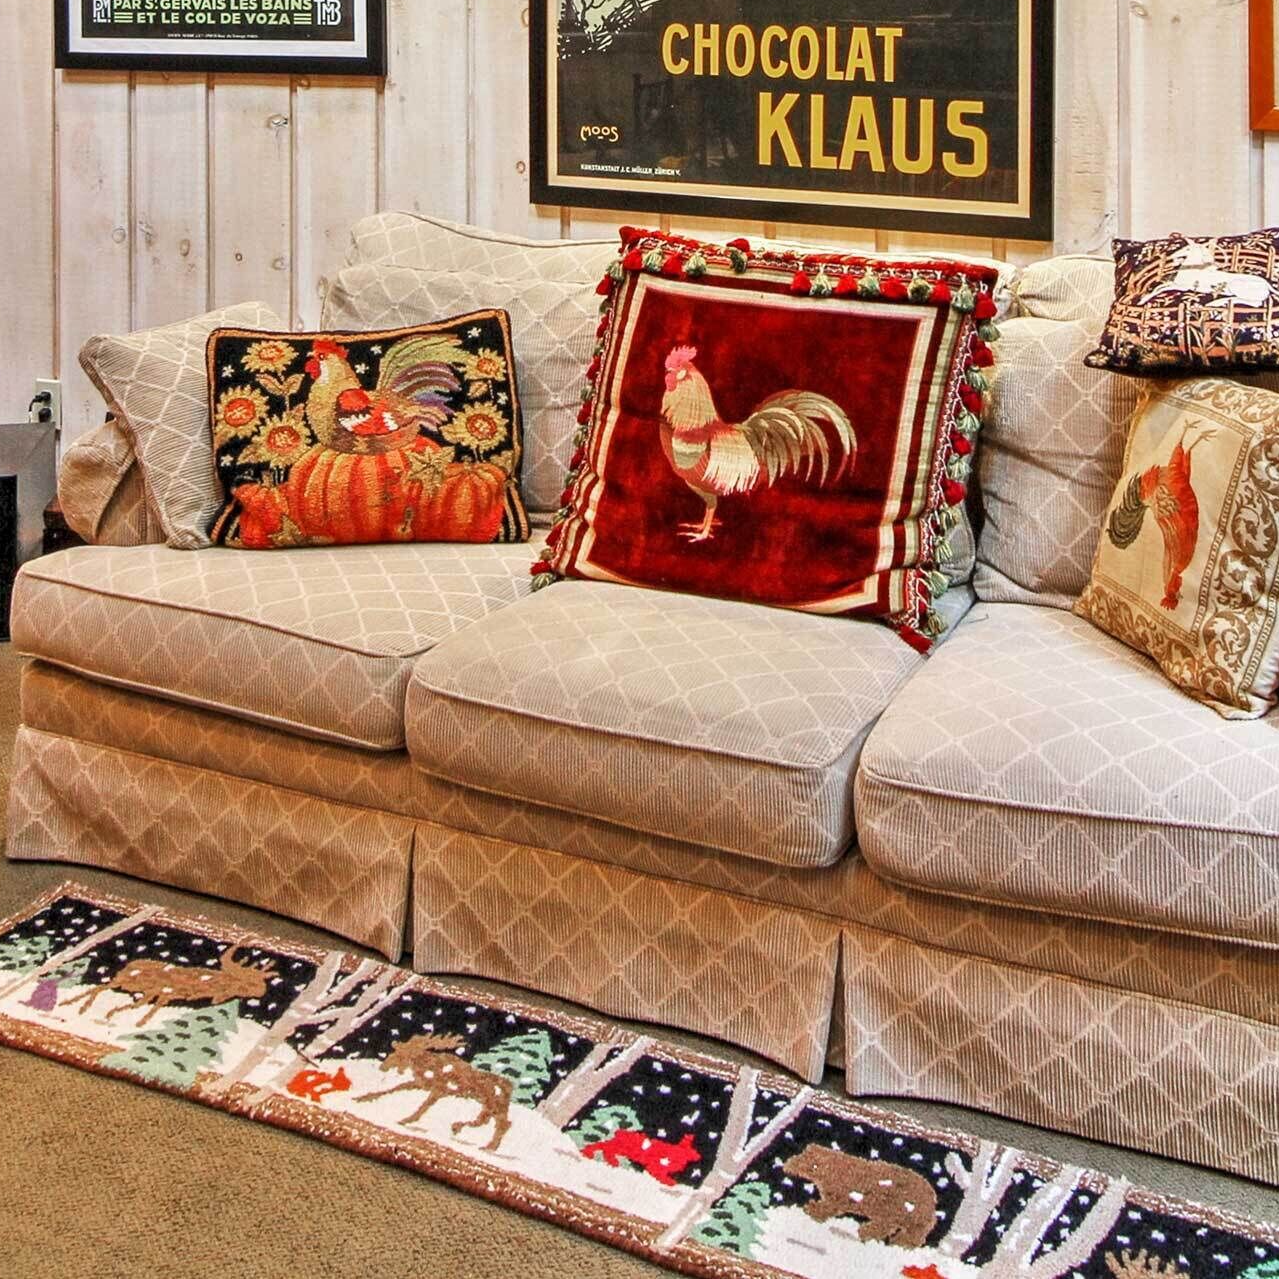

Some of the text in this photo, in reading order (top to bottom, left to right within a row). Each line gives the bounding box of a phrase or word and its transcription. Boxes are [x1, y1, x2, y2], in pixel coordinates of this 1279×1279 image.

[136, 12, 291, 25] ET LE COL DE VOZA
[660, 22, 904, 84] CHOCOLAT
[580, 125, 619, 142] MOOS
[756, 89, 989, 179] KLAUS
